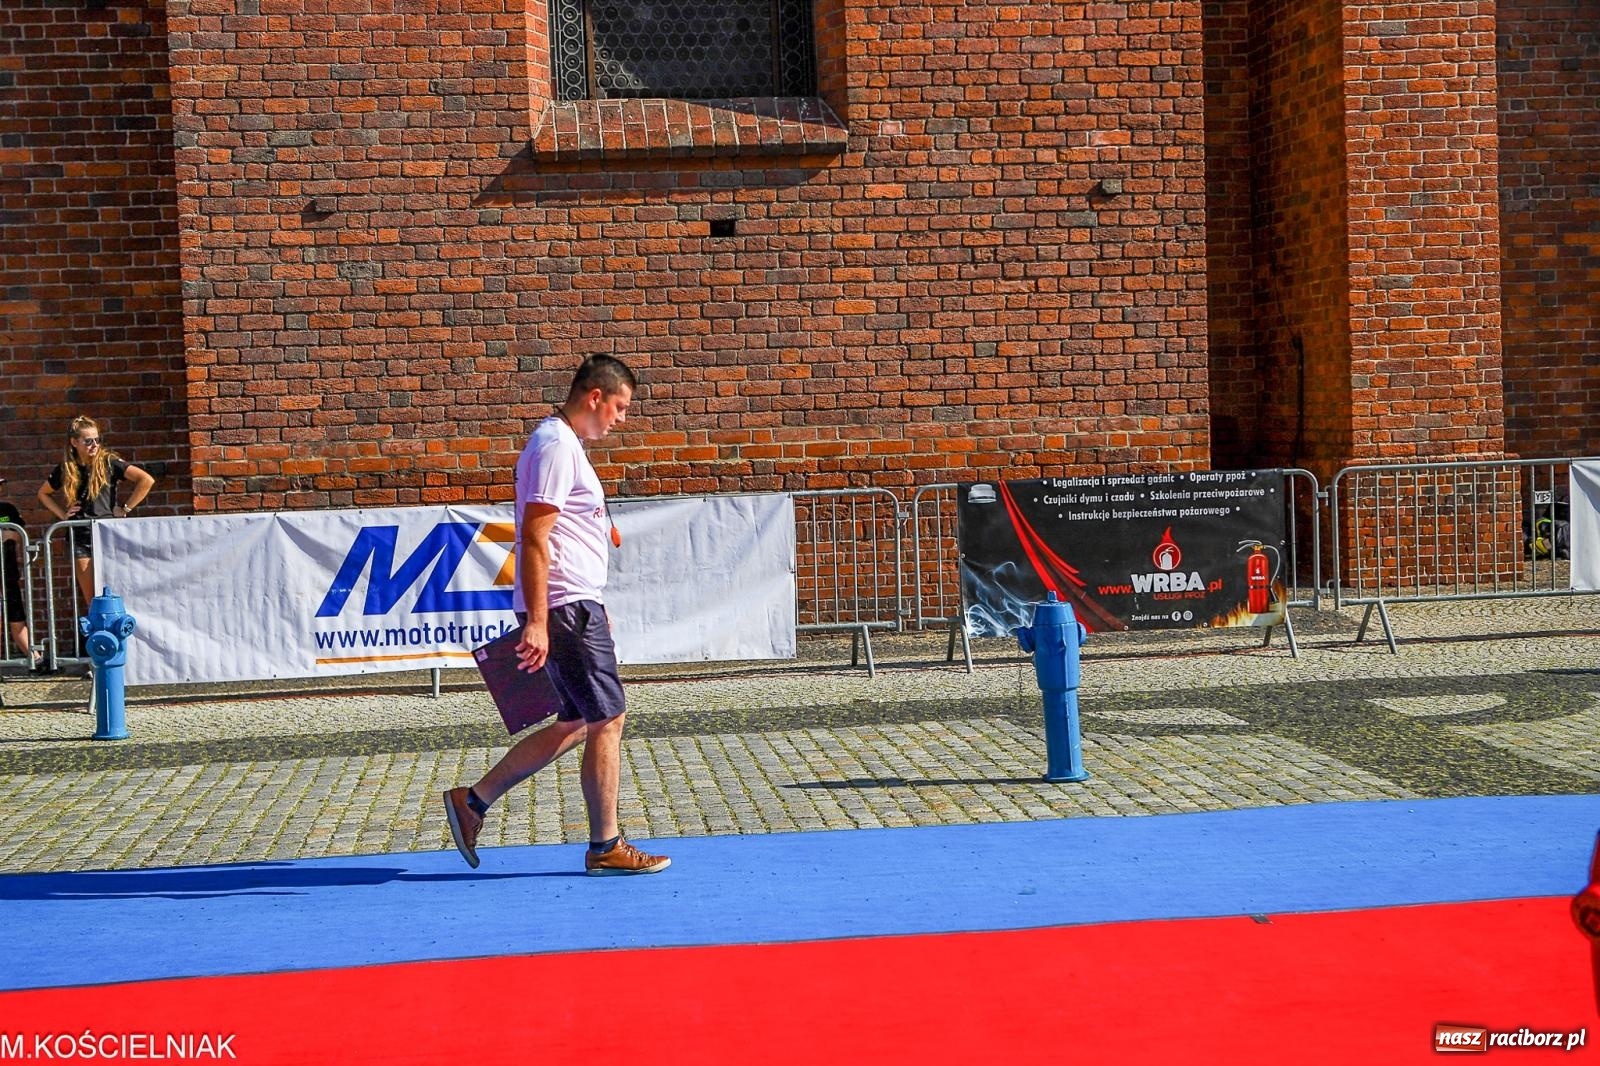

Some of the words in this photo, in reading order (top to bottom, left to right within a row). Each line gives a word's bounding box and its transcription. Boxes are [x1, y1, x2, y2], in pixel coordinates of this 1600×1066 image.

[1053, 477, 1100, 489] Legalizacja
[1102, 476, 1106, 485] i
[1107, 474, 1145, 487] sprzedaż
[1147, 474, 1175, 485] gaśnic
[1189, 472, 1223, 483] Operaty
[1225, 471, 1247, 482] ppoż
[1043, 494, 1078, 506] Czujniki
[1080, 493, 1103, 504] dymu
[1105, 492, 1109, 502] i
[1110, 491, 1135, 502] czadu
[1150, 489, 1191, 501] Szkolenia
[1193, 487, 1265, 500] przeciwpożarowe
[1068, 509, 1110, 521] Instrukcje
[1112, 507, 1177, 520] bezpieczeństwa
[1179, 506, 1231, 518] pożarowego
